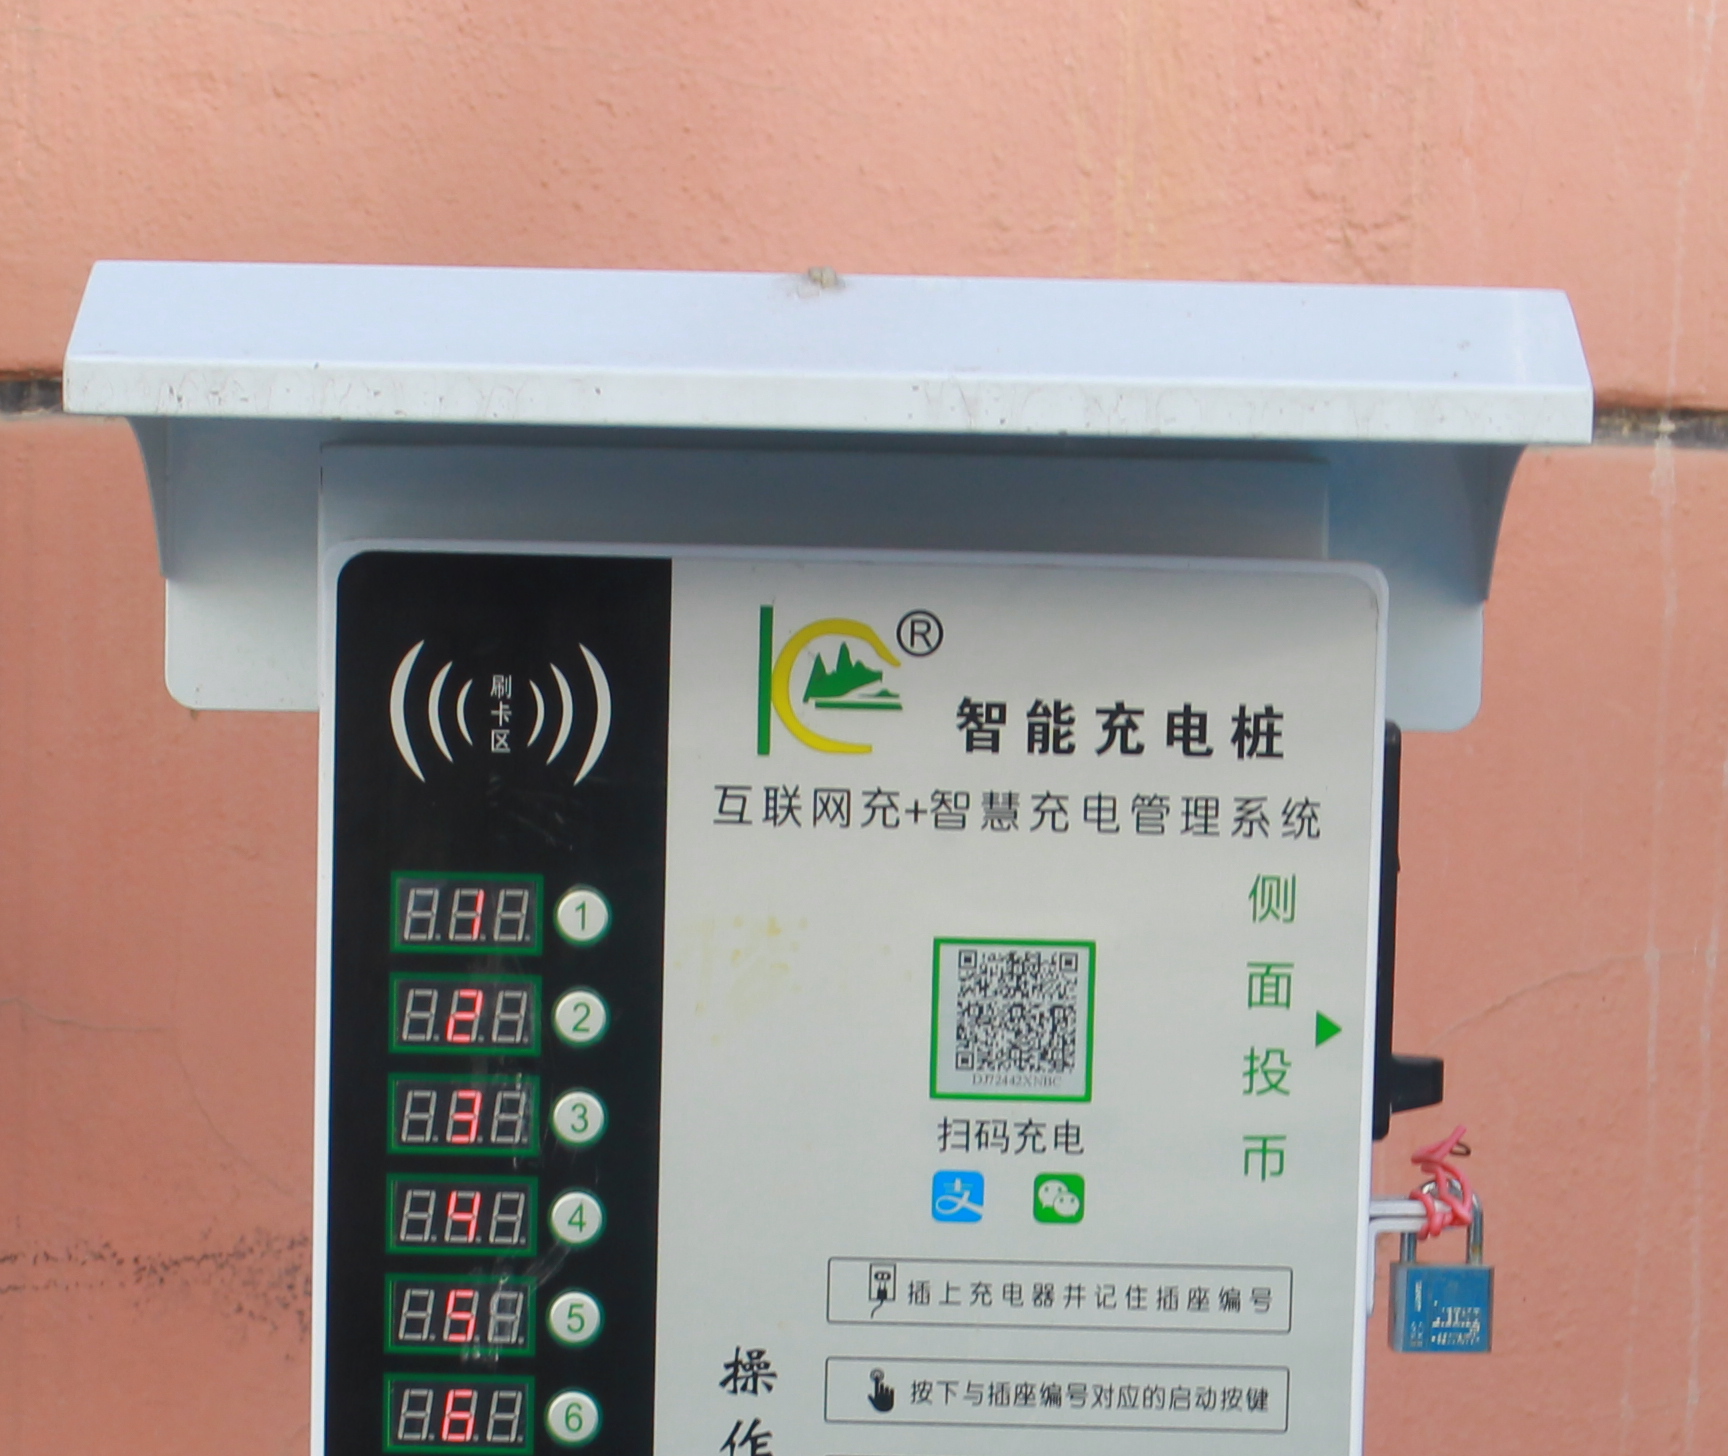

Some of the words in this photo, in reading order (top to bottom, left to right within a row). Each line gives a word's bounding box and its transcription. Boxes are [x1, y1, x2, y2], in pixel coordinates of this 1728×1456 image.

[490, 674, 513, 754] 刷卡区
[956, 697, 1285, 760] 智能充电桩
[712, 783, 1323, 840] 互联网充+智慧充电管理系统
[574, 900, 587, 931] 1
[572, 1001, 591, 1033] 2
[1240, 872, 1297, 1184] 侧面投币
[570, 1102, 589, 1134] 3
[937, 1116, 1085, 1156] 扫码充电
[567, 1202, 587, 1234] 4
[566, 1302, 585, 1334] 5
[909, 1379, 1270, 1413] 按下与插座编号对应的启动按键
[564, 1401, 583, 1433] 6
